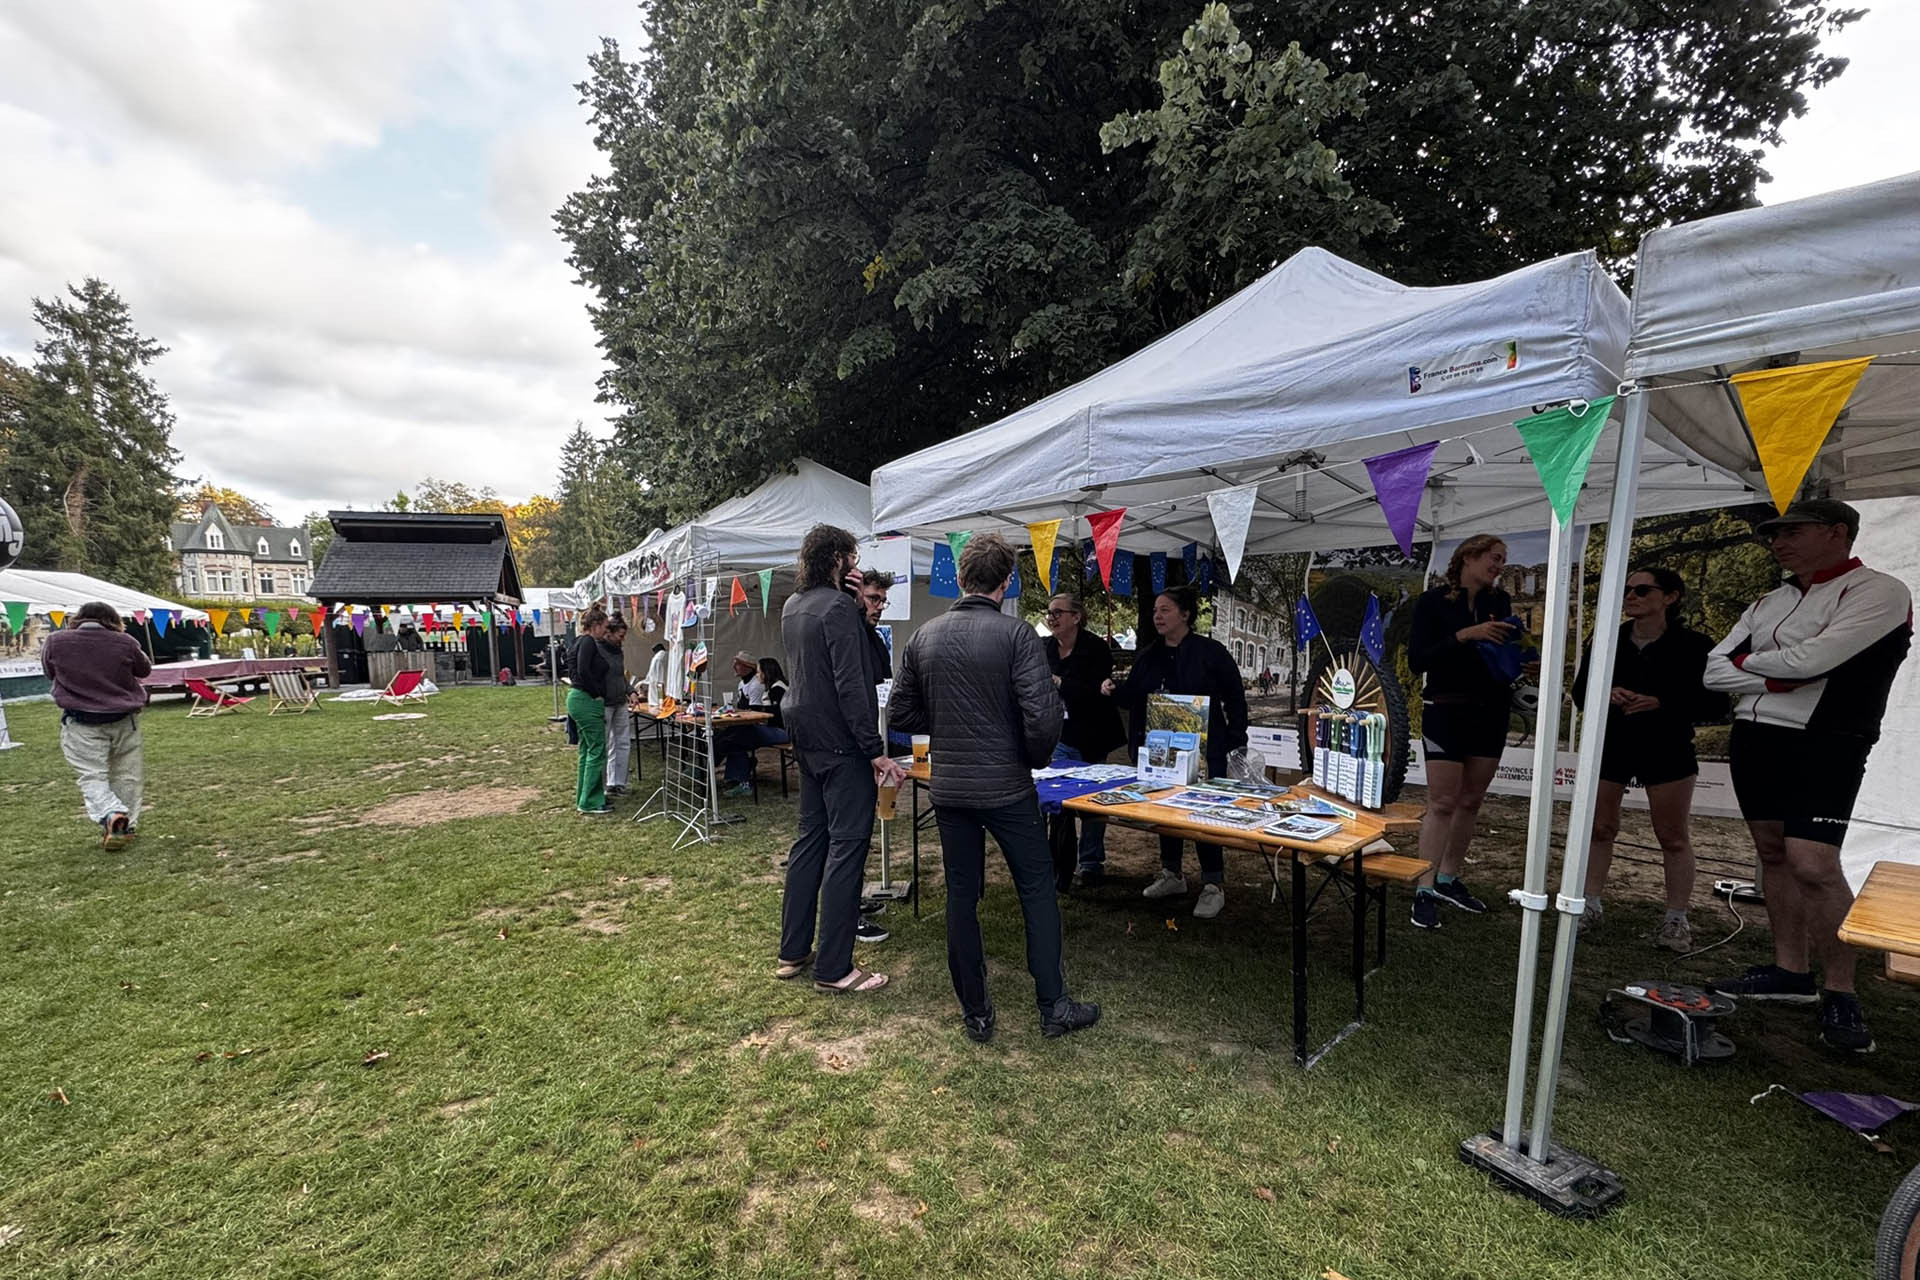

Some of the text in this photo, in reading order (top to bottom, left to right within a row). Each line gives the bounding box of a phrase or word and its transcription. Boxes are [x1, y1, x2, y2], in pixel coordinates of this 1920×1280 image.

[1423, 357, 1498, 379] France Barnums.com
[1497, 766, 1528, 774] PROVINCE
